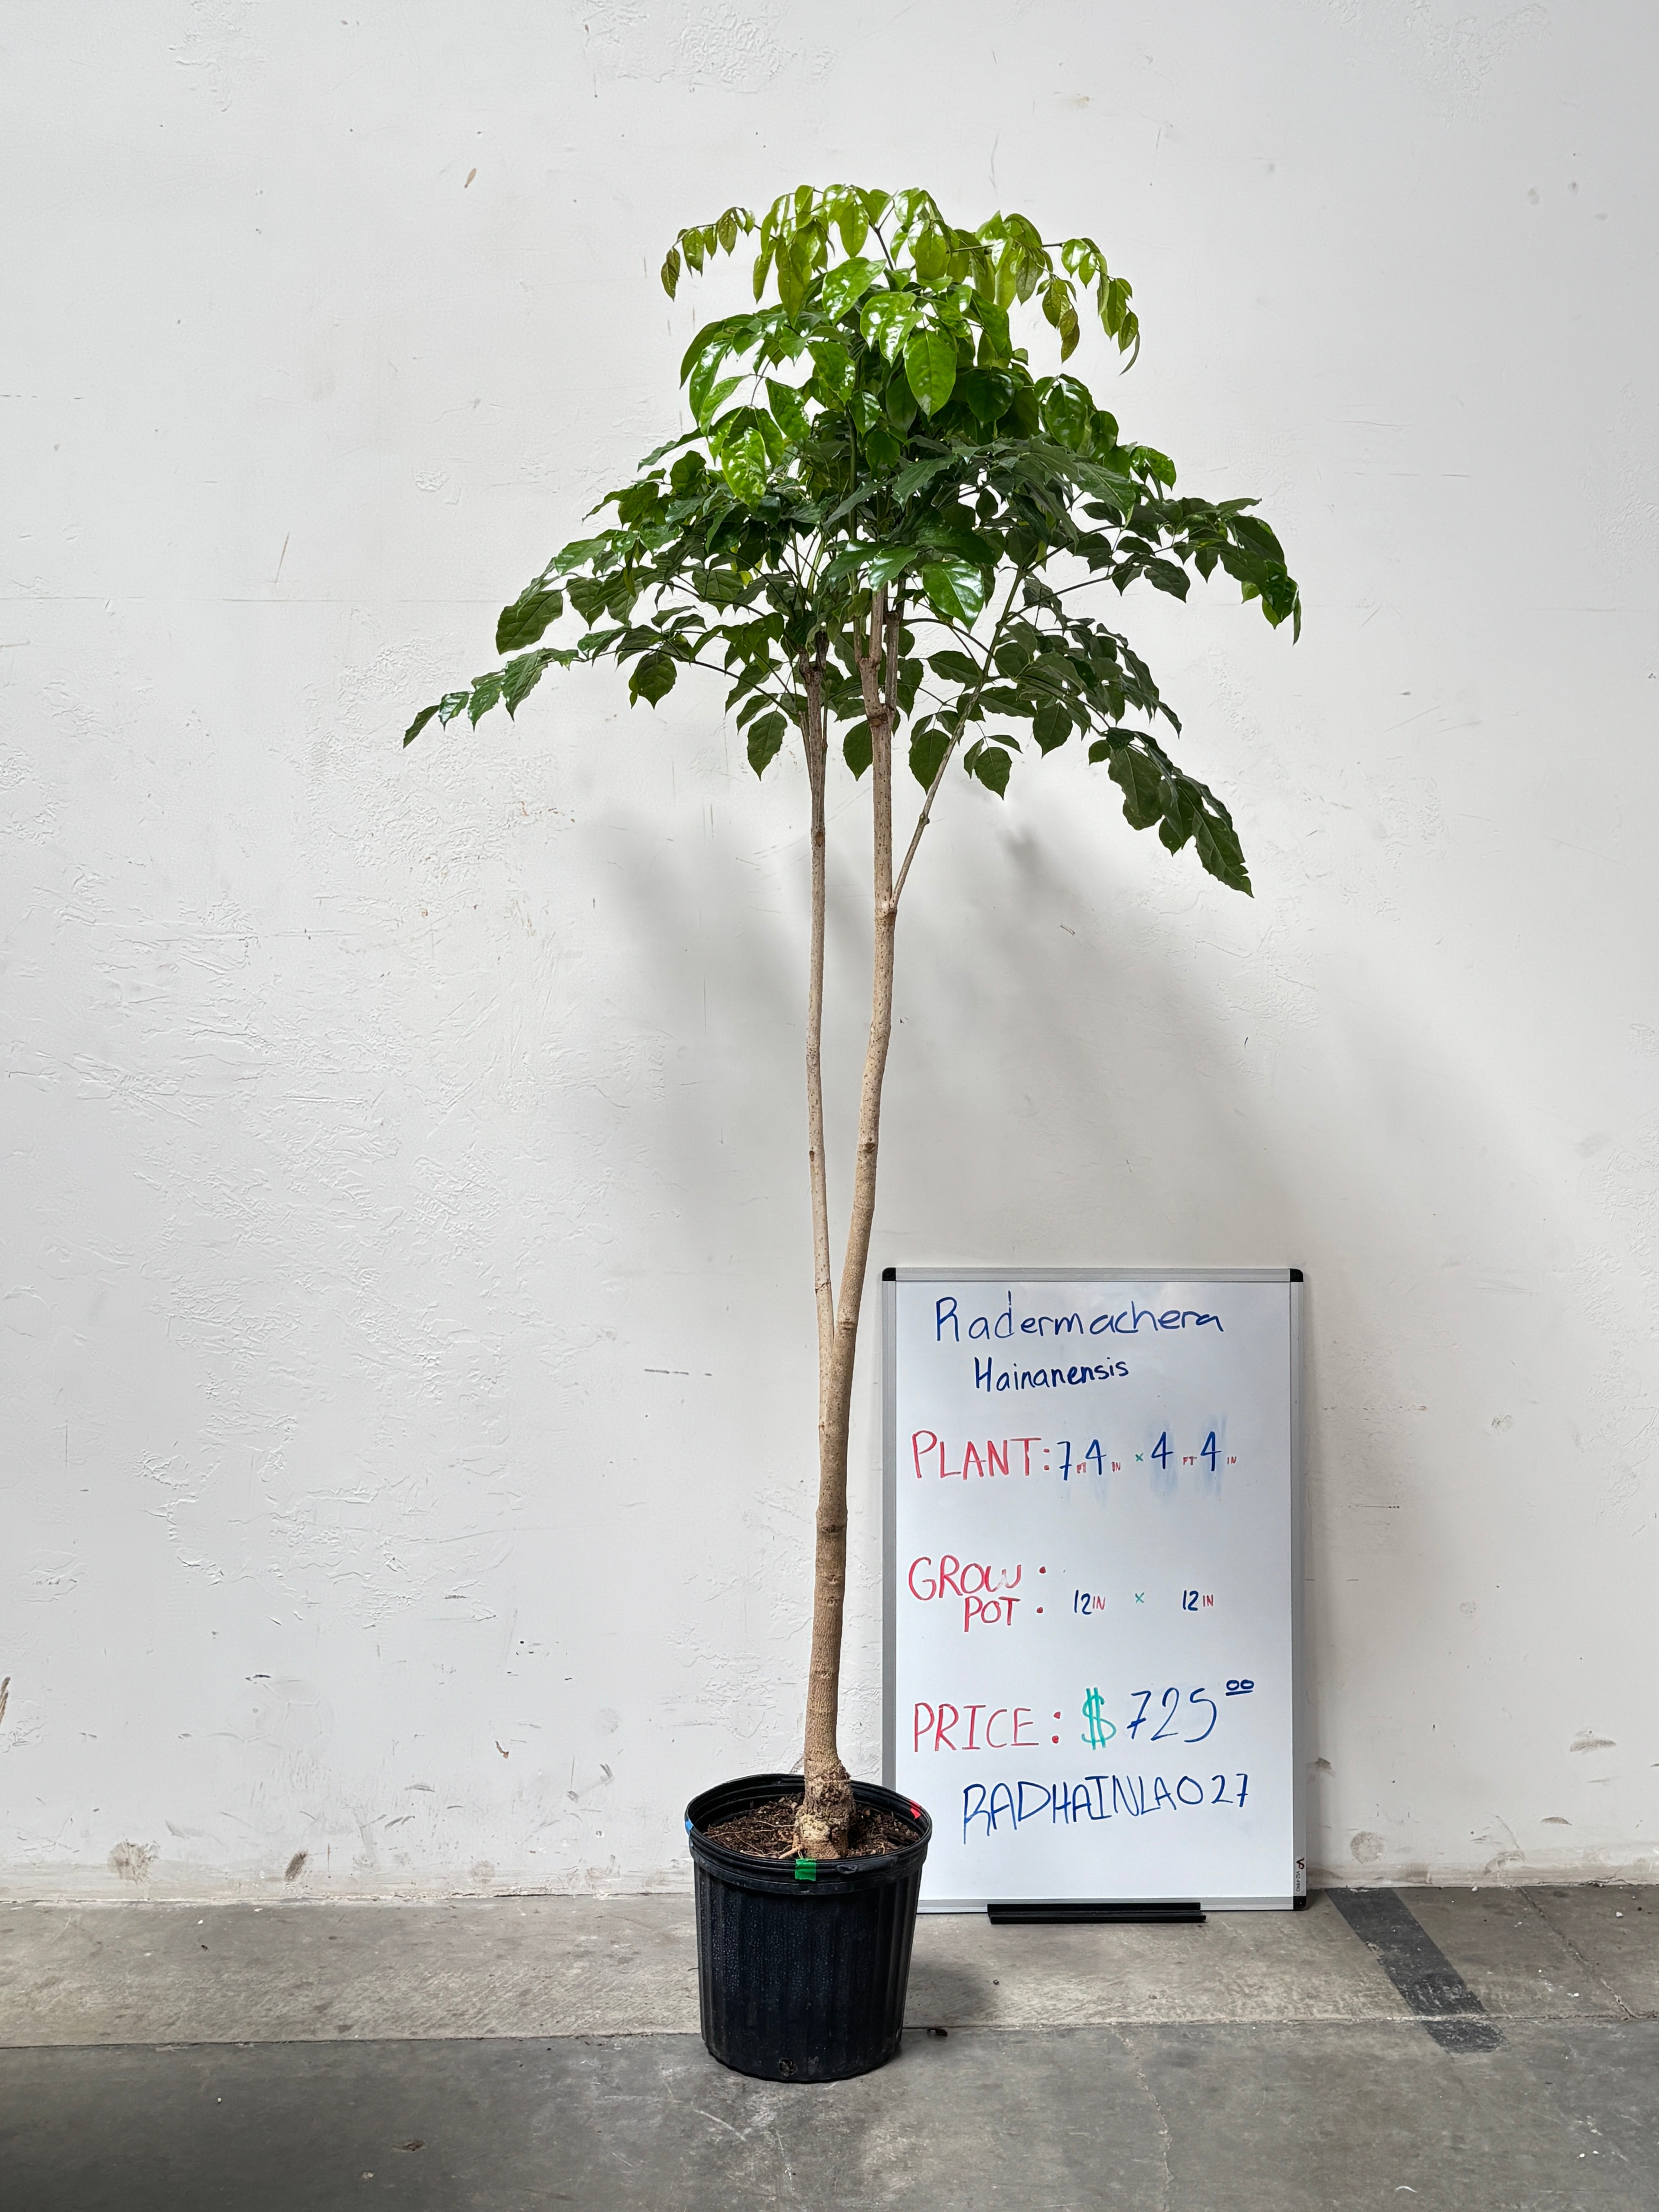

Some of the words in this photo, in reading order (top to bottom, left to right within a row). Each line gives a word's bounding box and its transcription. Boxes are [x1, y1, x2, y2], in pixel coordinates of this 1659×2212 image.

[936, 1290, 1224, 1342] Radermachera
[974, 1356, 1130, 1393] Hainanensis
[912, 1430, 1050, 1480] PLANT:
